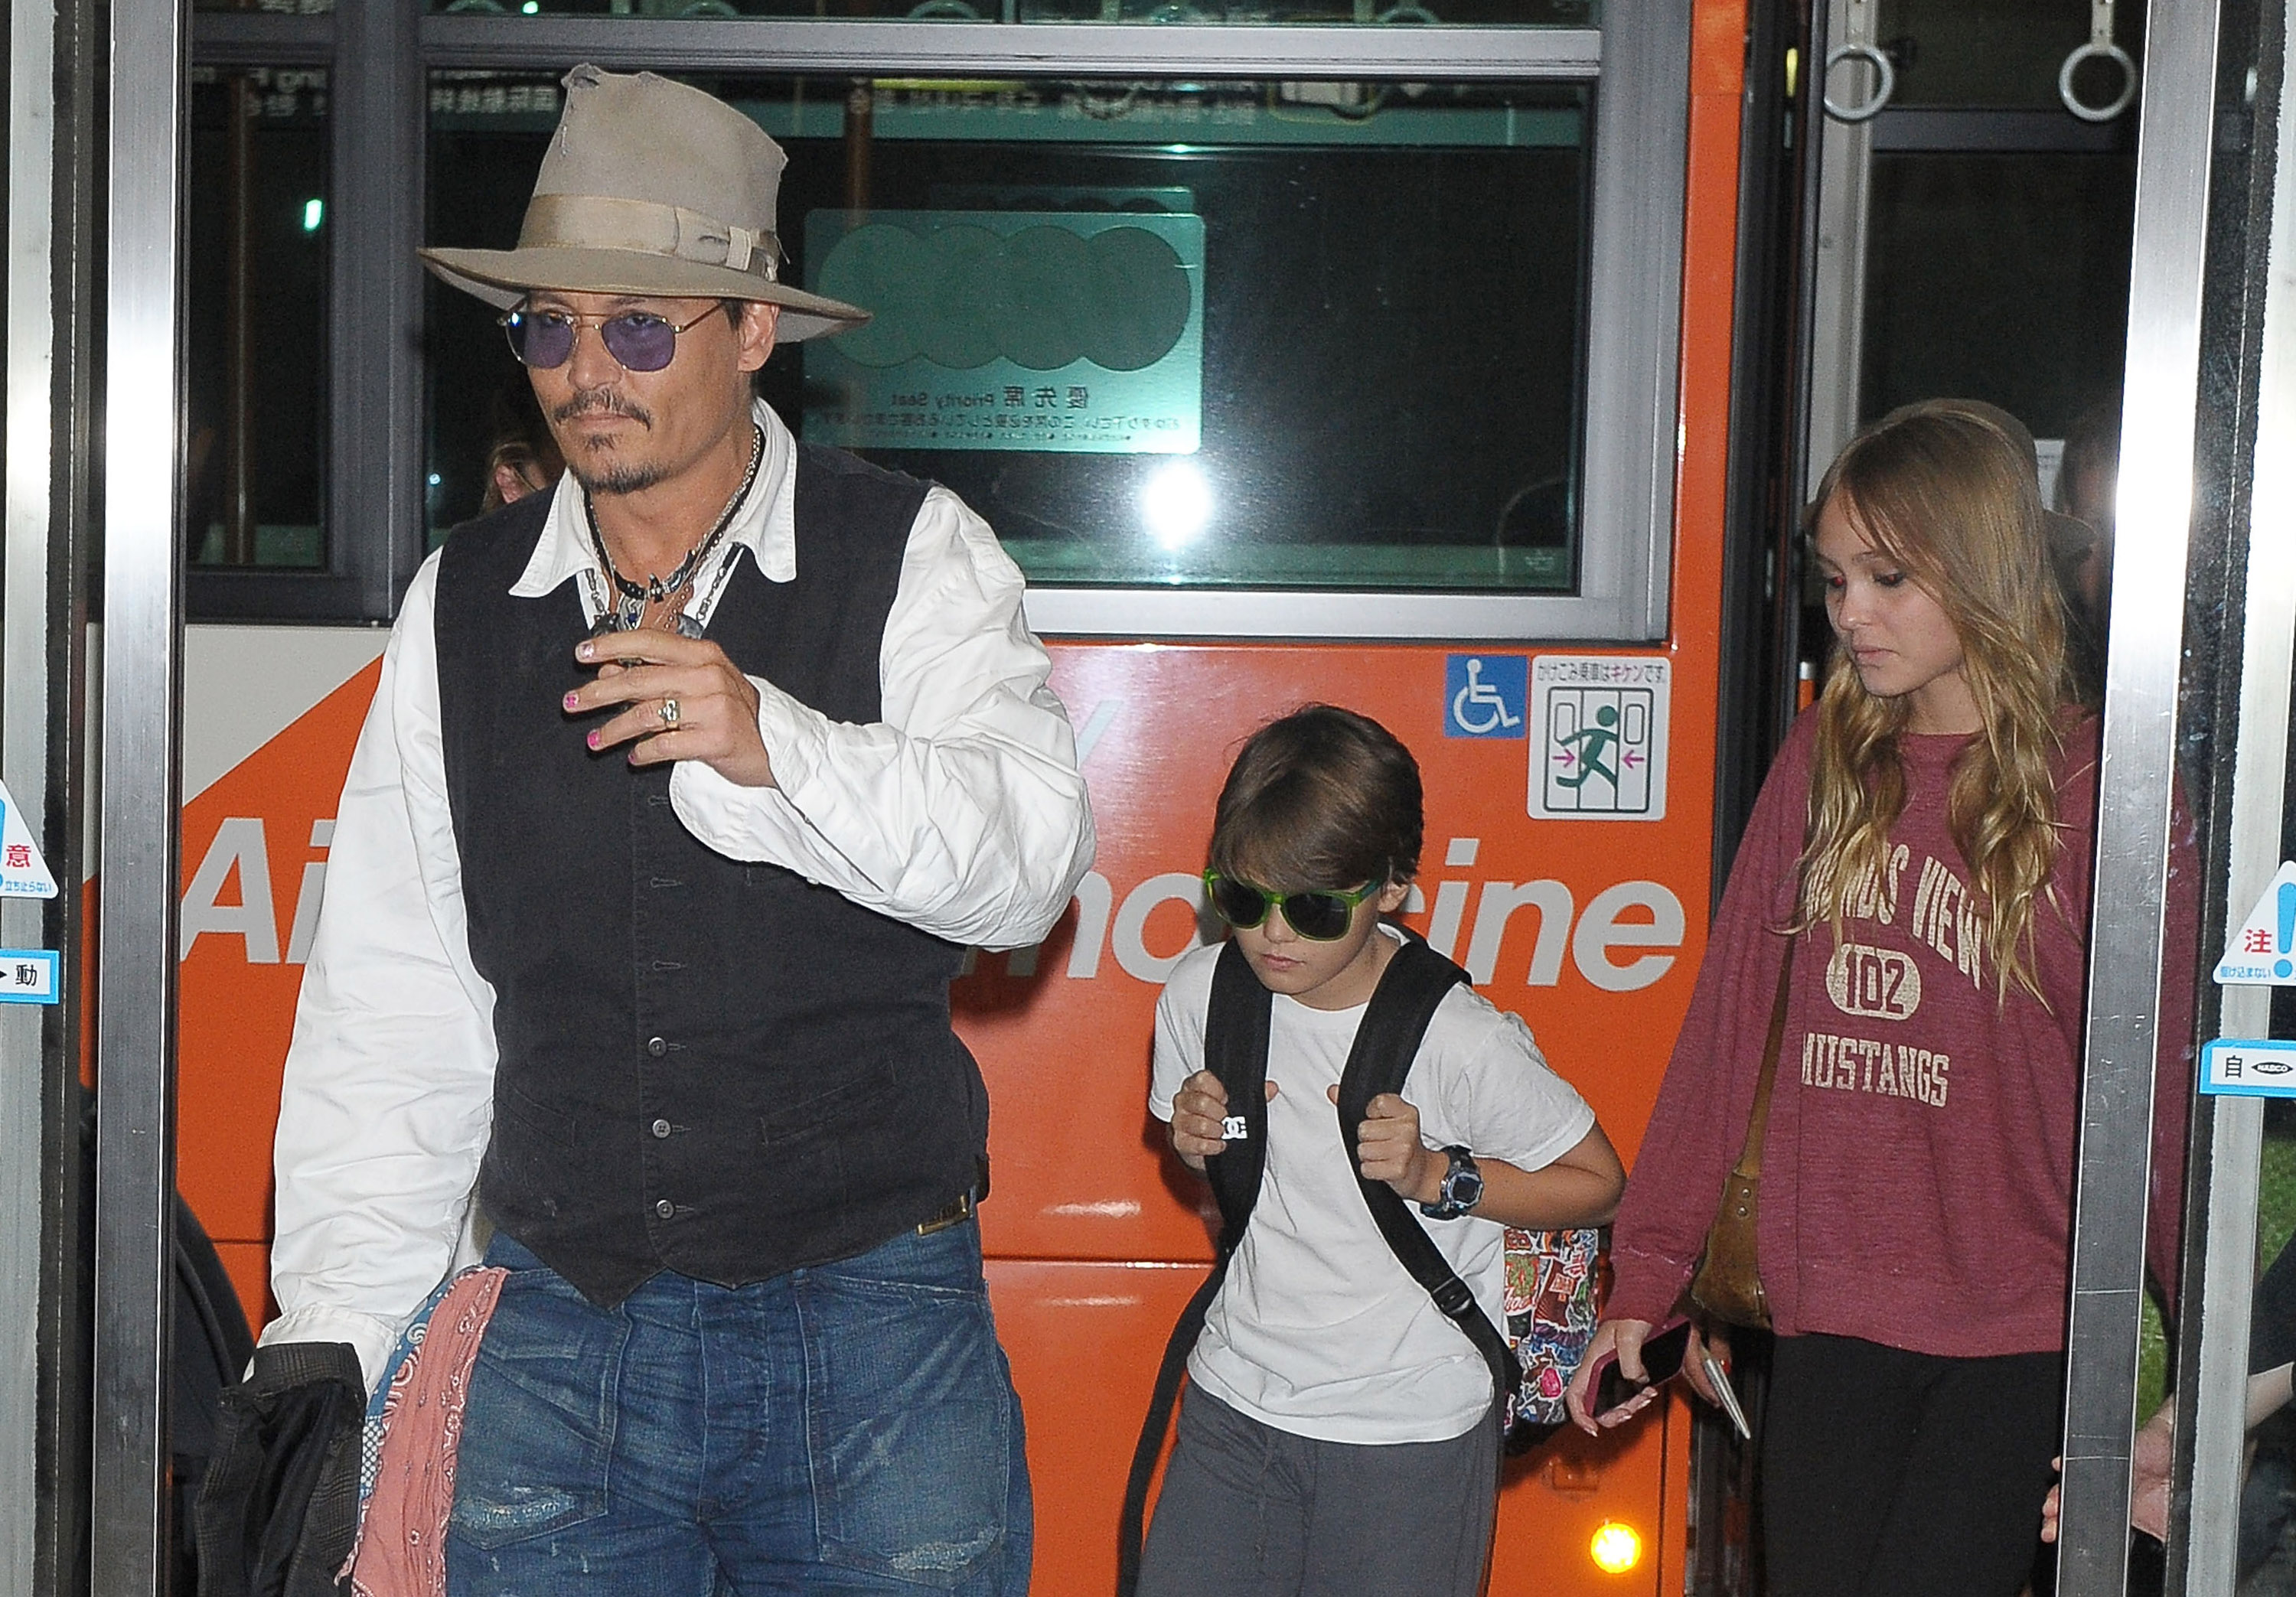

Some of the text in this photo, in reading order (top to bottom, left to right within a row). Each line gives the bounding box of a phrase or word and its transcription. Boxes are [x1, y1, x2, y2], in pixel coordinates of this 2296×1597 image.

[6, 845, 31, 868] 意
[1912, 856, 1981, 990] VIEW
[2244, 929, 2272, 953] 注
[15, 965, 38, 986] 動
[1846, 953, 1906, 1014] 102
[2225, 1055, 2242, 1078] 自
